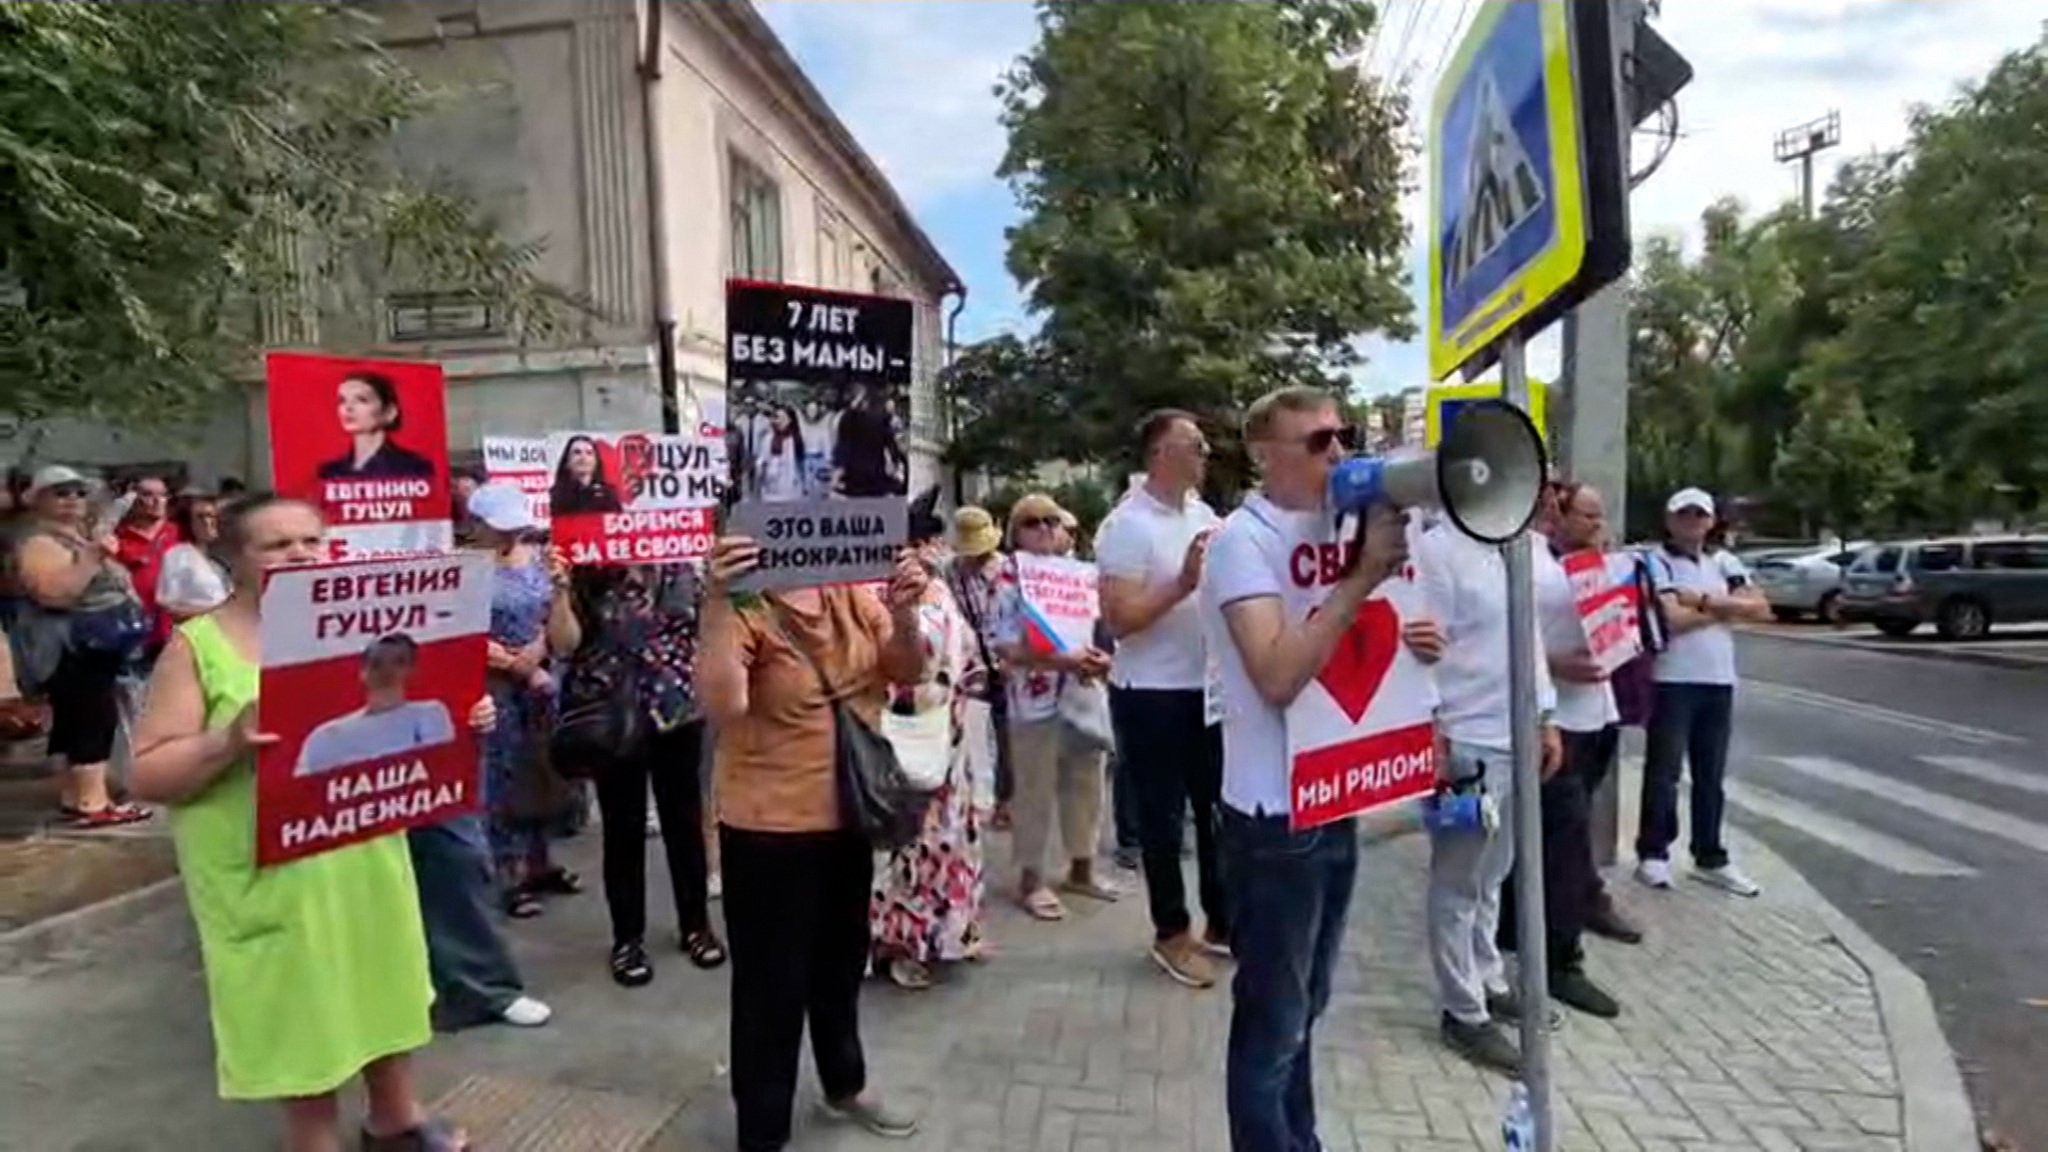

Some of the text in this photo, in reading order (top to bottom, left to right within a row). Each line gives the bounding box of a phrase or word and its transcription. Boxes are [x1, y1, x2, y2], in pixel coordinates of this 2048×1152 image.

[787, 300, 860, 333] 7 ЛЕТ
[731, 333, 786, 364] БЕЗ
[792, 338, 884, 373] МАМЫ
[624, 443, 710, 471] ГУЦУЛ
[324, 479, 431, 501] ЕВГЕНИЮ
[628, 473, 680, 499] ЭТО
[342, 501, 413, 521] ГУЦУЛ
[603, 509, 705, 536] БОРЕМСЯ
[765, 514, 886, 539] ЭТО ВАША
[571, 542, 601, 564] ЗА
[606, 539, 632, 561] ЕЕ
[311, 566, 463, 604] ЕВГЕНИЯ
[316, 604, 427, 640] ГУЦУЛ
[327, 759, 429, 804] НАША
[1297, 746, 1434, 813] МЫ РЯДОМ!
[281, 781, 464, 847] НАДЕЖДА!
